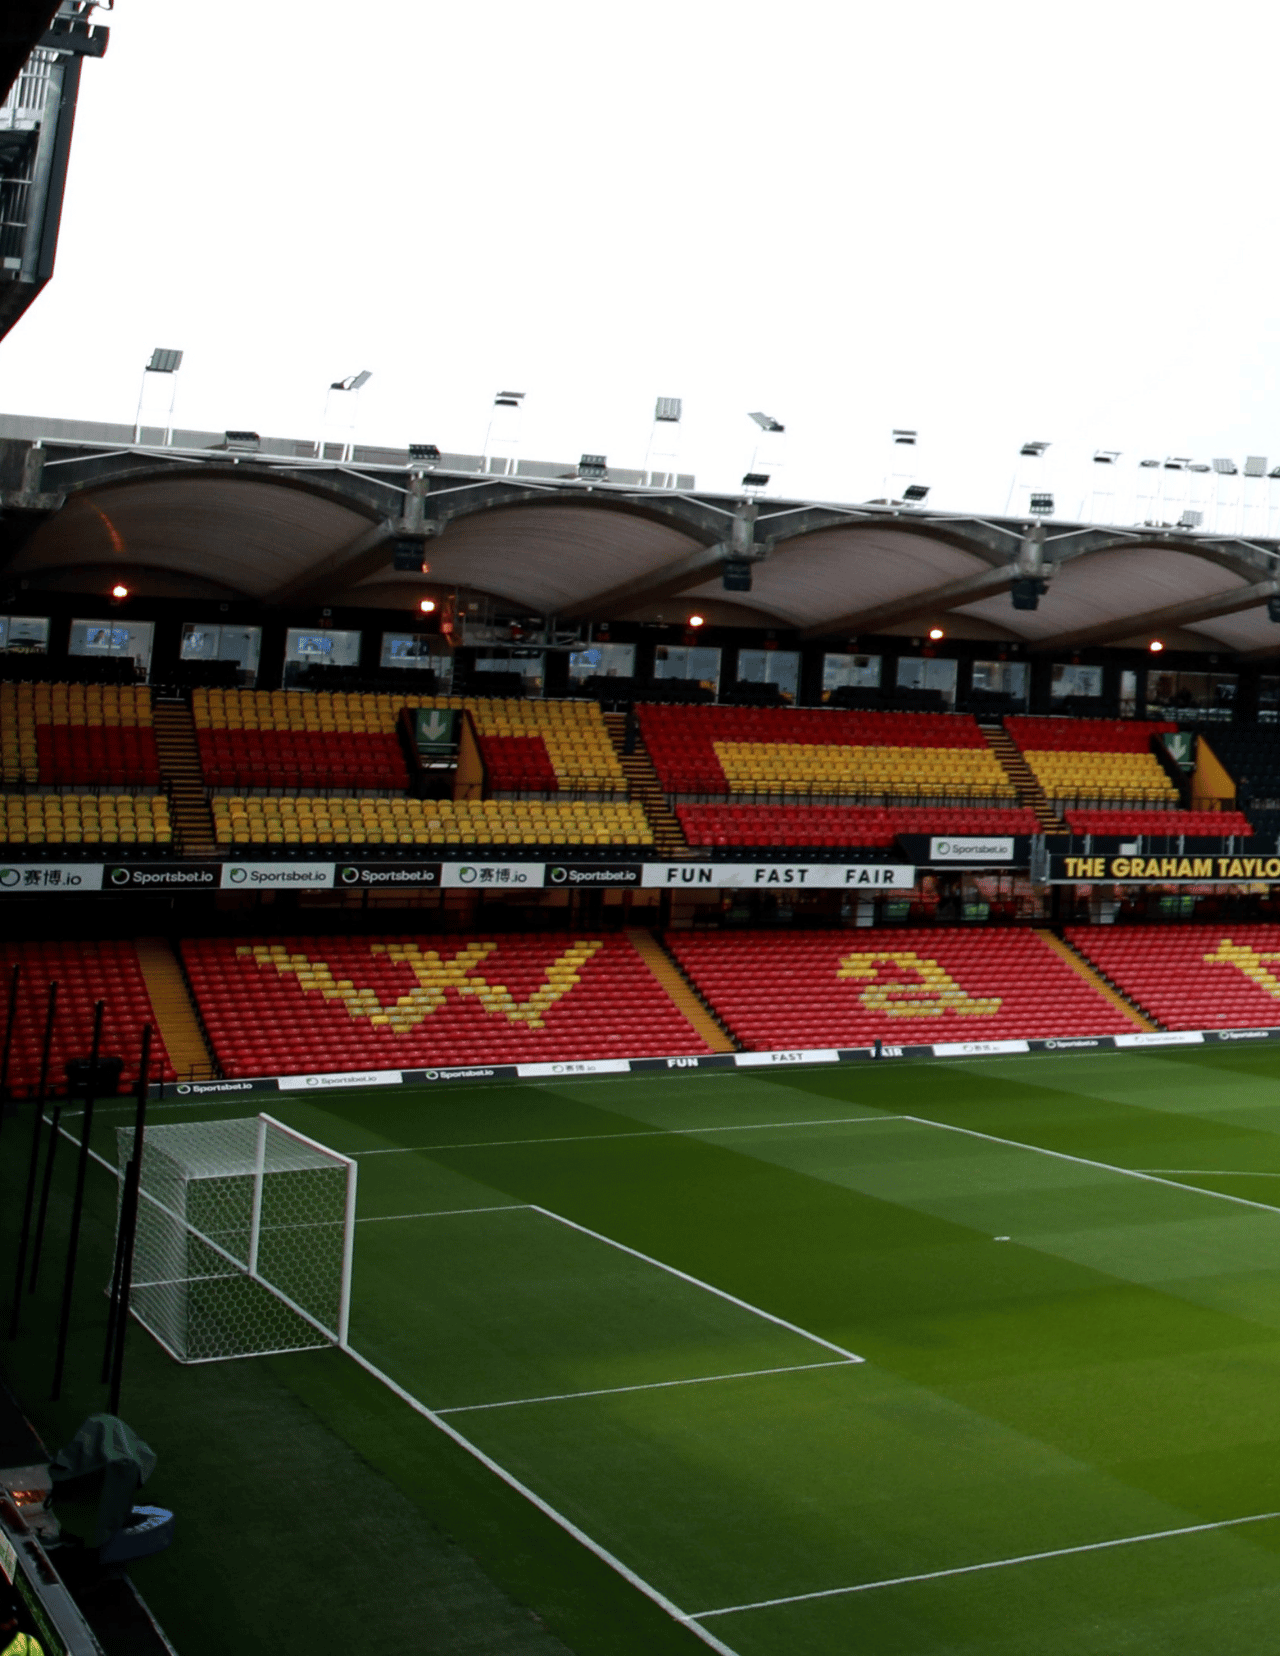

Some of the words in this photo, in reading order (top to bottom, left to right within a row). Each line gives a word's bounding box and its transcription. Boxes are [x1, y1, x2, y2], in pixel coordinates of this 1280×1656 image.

[951, 844, 1008, 855] Sportsbet.io
[1065, 858, 1105, 877] THE
[1111, 858, 1213, 877] GRAHAM
[132, 870, 214, 884] Sportsbet.io
[250, 870, 327, 884] Sportsbet.io
[361, 869, 435, 883] Sportsbet.io
[568, 869, 637, 883] Sportsbet.io
[667, 868, 713, 883] FUN
[755, 868, 809, 883] FAST
[845, 869, 895, 884] FAIR
[667, 1058, 698, 1068] FUN
[771, 1052, 804, 1062] FAST
[321, 1074, 378, 1085] Sportsbet.io
[440, 1069, 494, 1079] Sportsbet.io
[192, 1082, 253, 1093] Sportsbet.io
